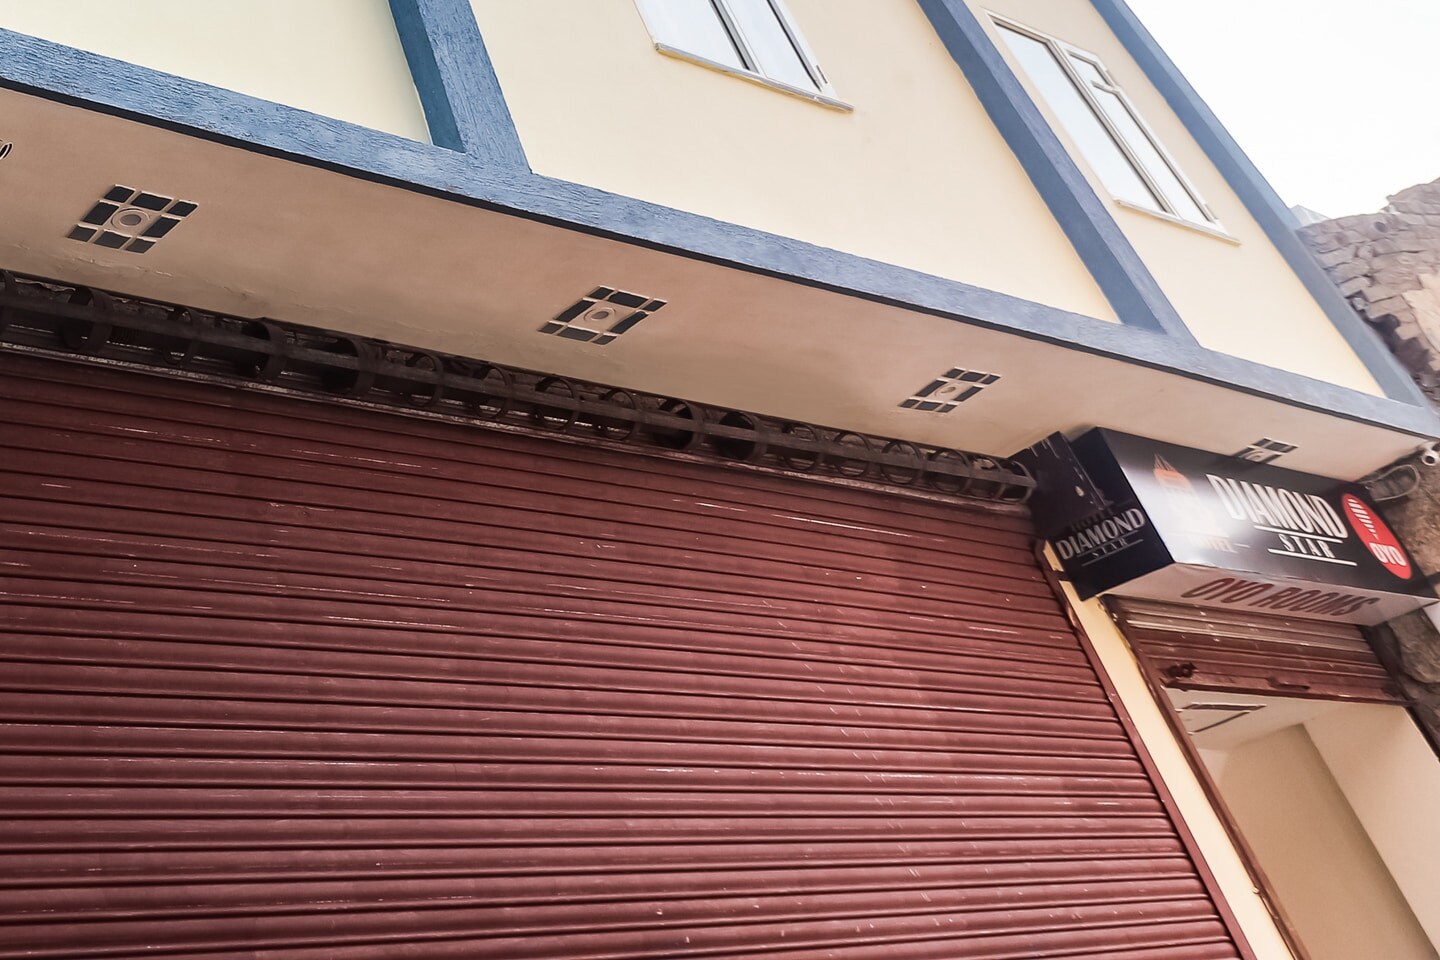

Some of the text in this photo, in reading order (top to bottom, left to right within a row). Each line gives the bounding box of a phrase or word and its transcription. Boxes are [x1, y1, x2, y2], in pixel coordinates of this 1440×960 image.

[1206, 474, 1348, 539] DIAMOND
[1055, 508, 1146, 560] DIAMOND
[1278, 533, 1336, 558] STAR
[1369, 542, 1407, 567] OYO
[1181, 578, 1381, 616] OYO ROOMS
